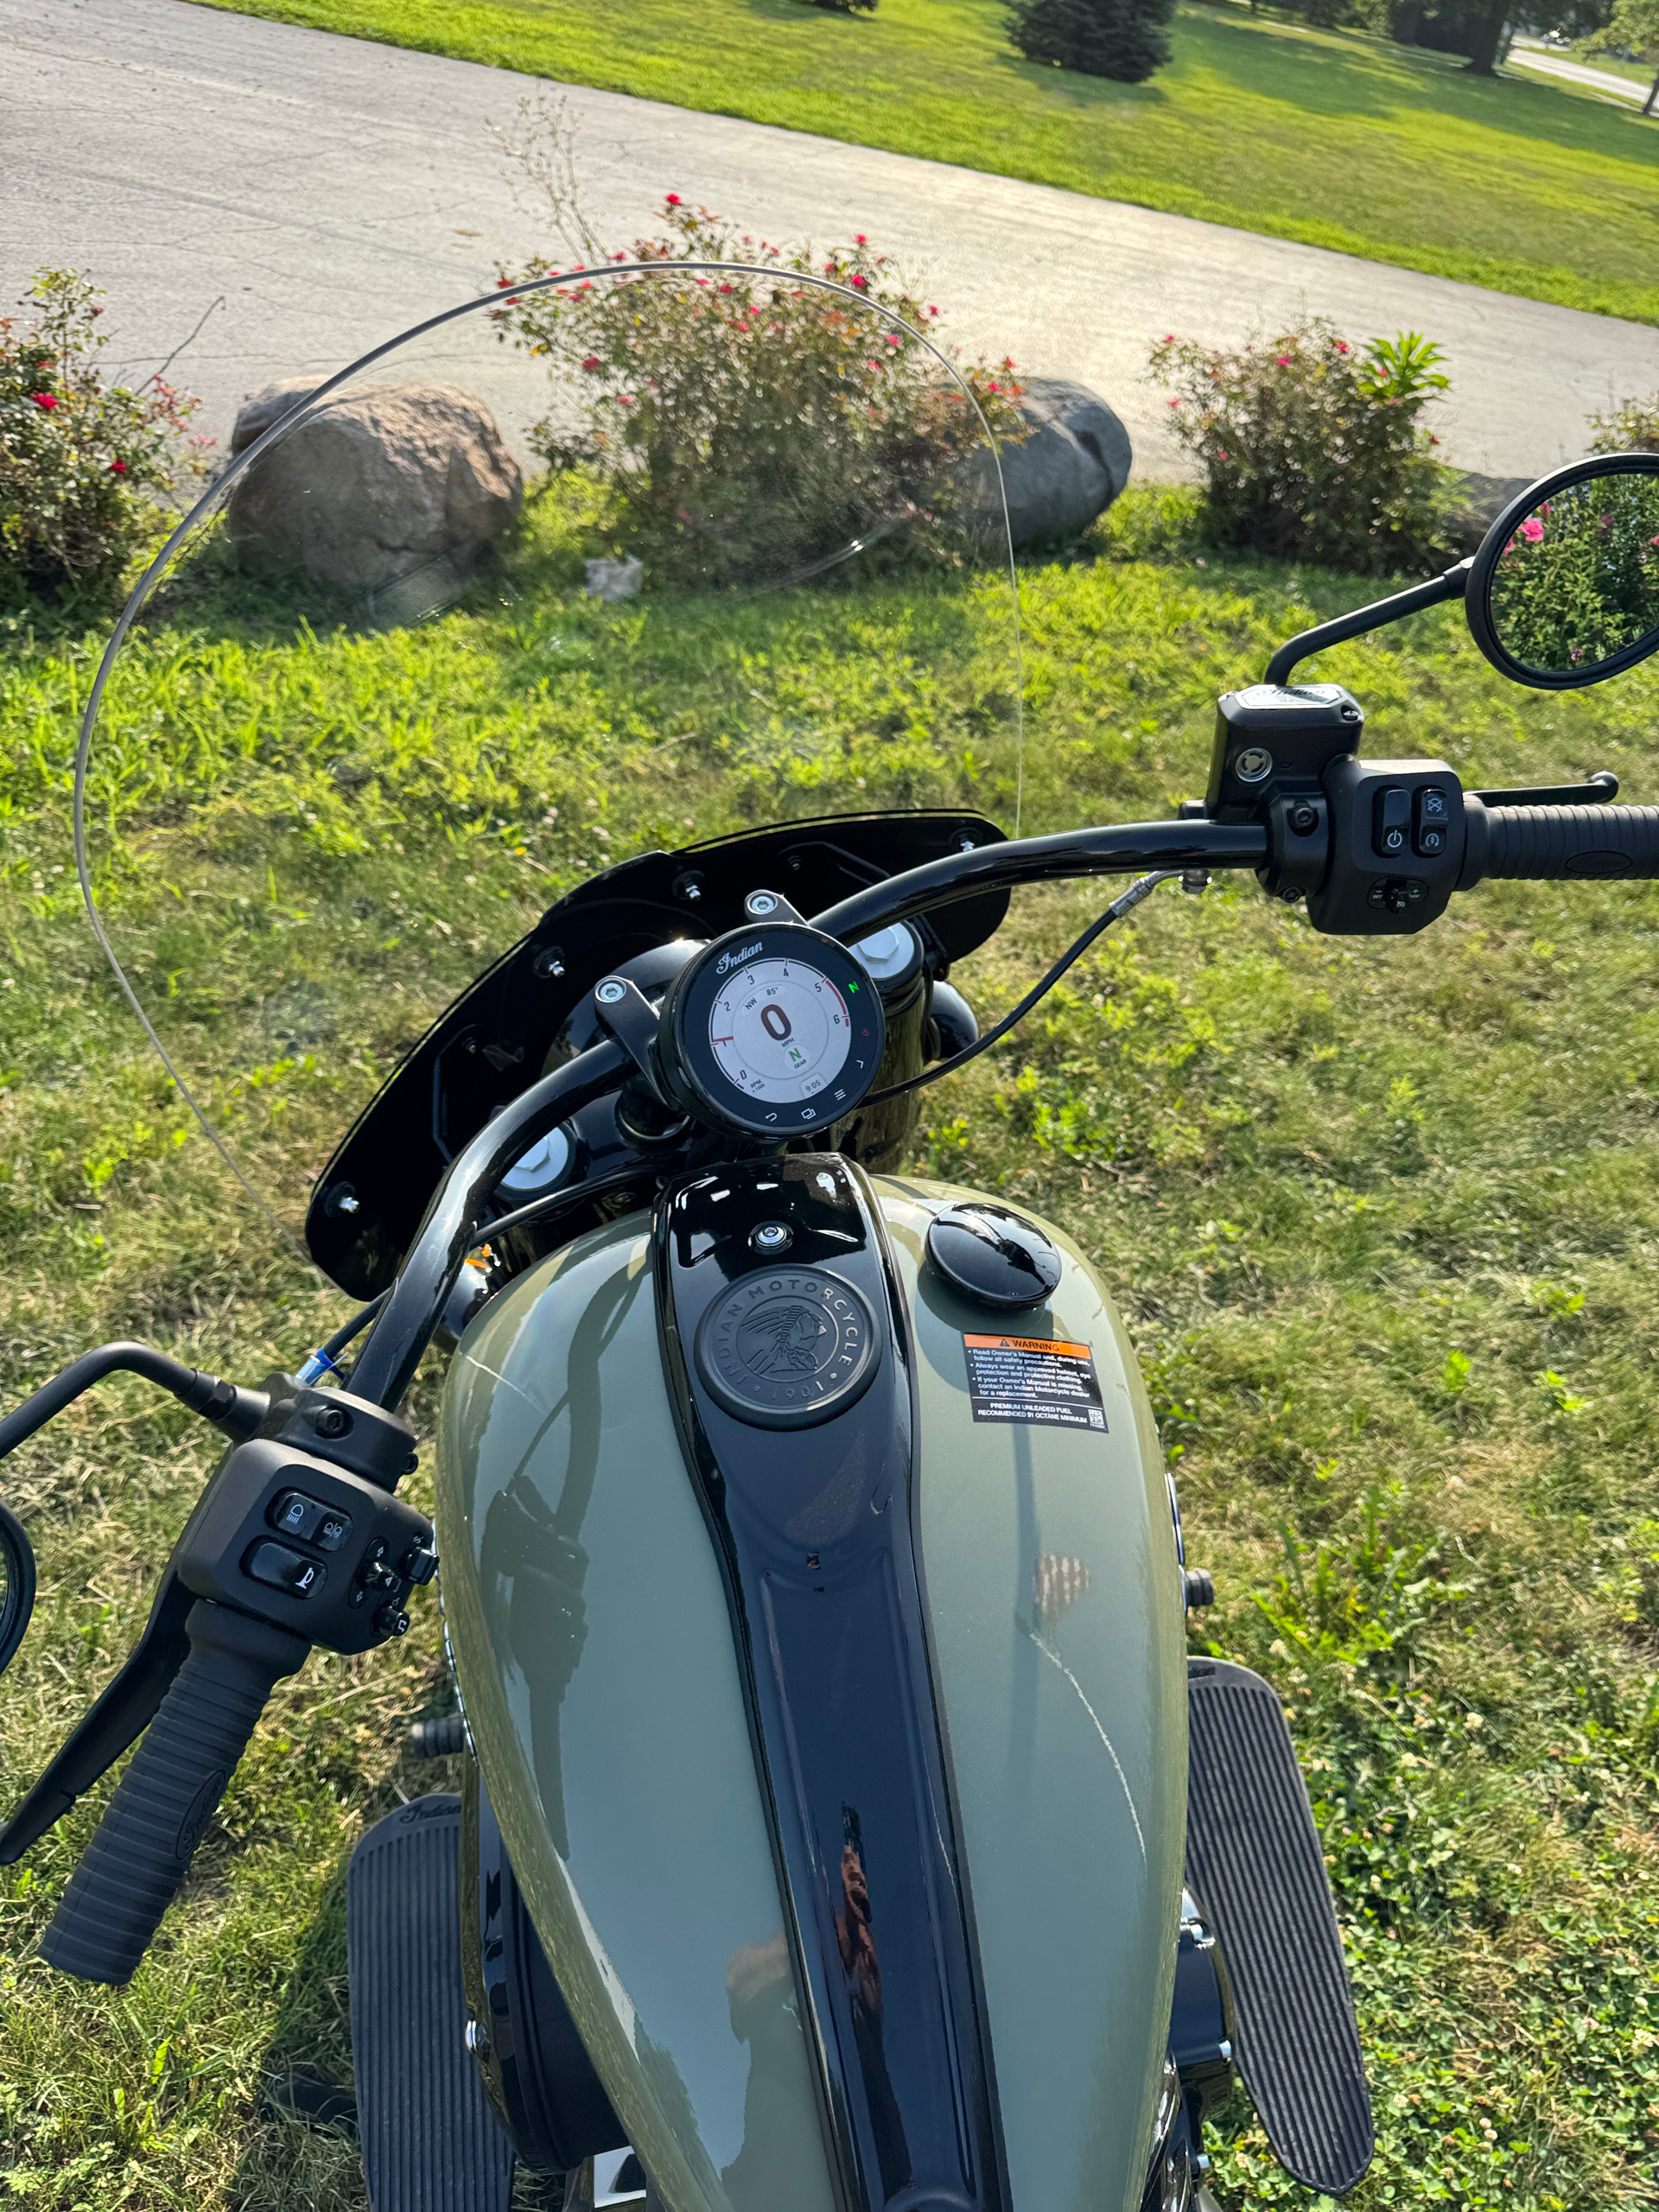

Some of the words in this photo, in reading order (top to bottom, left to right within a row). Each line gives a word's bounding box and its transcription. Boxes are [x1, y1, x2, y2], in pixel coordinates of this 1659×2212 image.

[716, 942, 763, 974] Indian
[784, 968, 789, 976] 4
[747, 975, 755, 985] 3
[766, 987, 779, 995] 85°
[815, 982, 822, 993] 5
[849, 981, 860, 993] N
[724, 1001, 731, 1011] 2
[745, 997, 757, 1009] NW
[761, 1004, 791, 1040] 0
[833, 1014, 840, 1024] 6
[782, 1038, 794, 1047] MPH
[788, 1047, 802, 1062] N
[794, 1058, 807, 1069] GEAR
[740, 1069, 747, 1079] 0
[750, 1079, 762, 1088] RPM
[805, 1079, 821, 1092] 9:05
[718, 1303, 748, 1384] INDIAN
[748, 1279, 858, 1366] MOTORCYCLE
[1012, 1339, 1059, 1351] WARNING
[1024, 1358, 1062, 1367] precautions.
[1057, 1356, 1077, 1364] during
[1056, 1369, 1079, 1377] helmet,
[772, 1381, 823, 1400] 1901
[1034, 1386, 1070, 1395] Motorcycle
[399, 1803, 461, 1824] Indian
